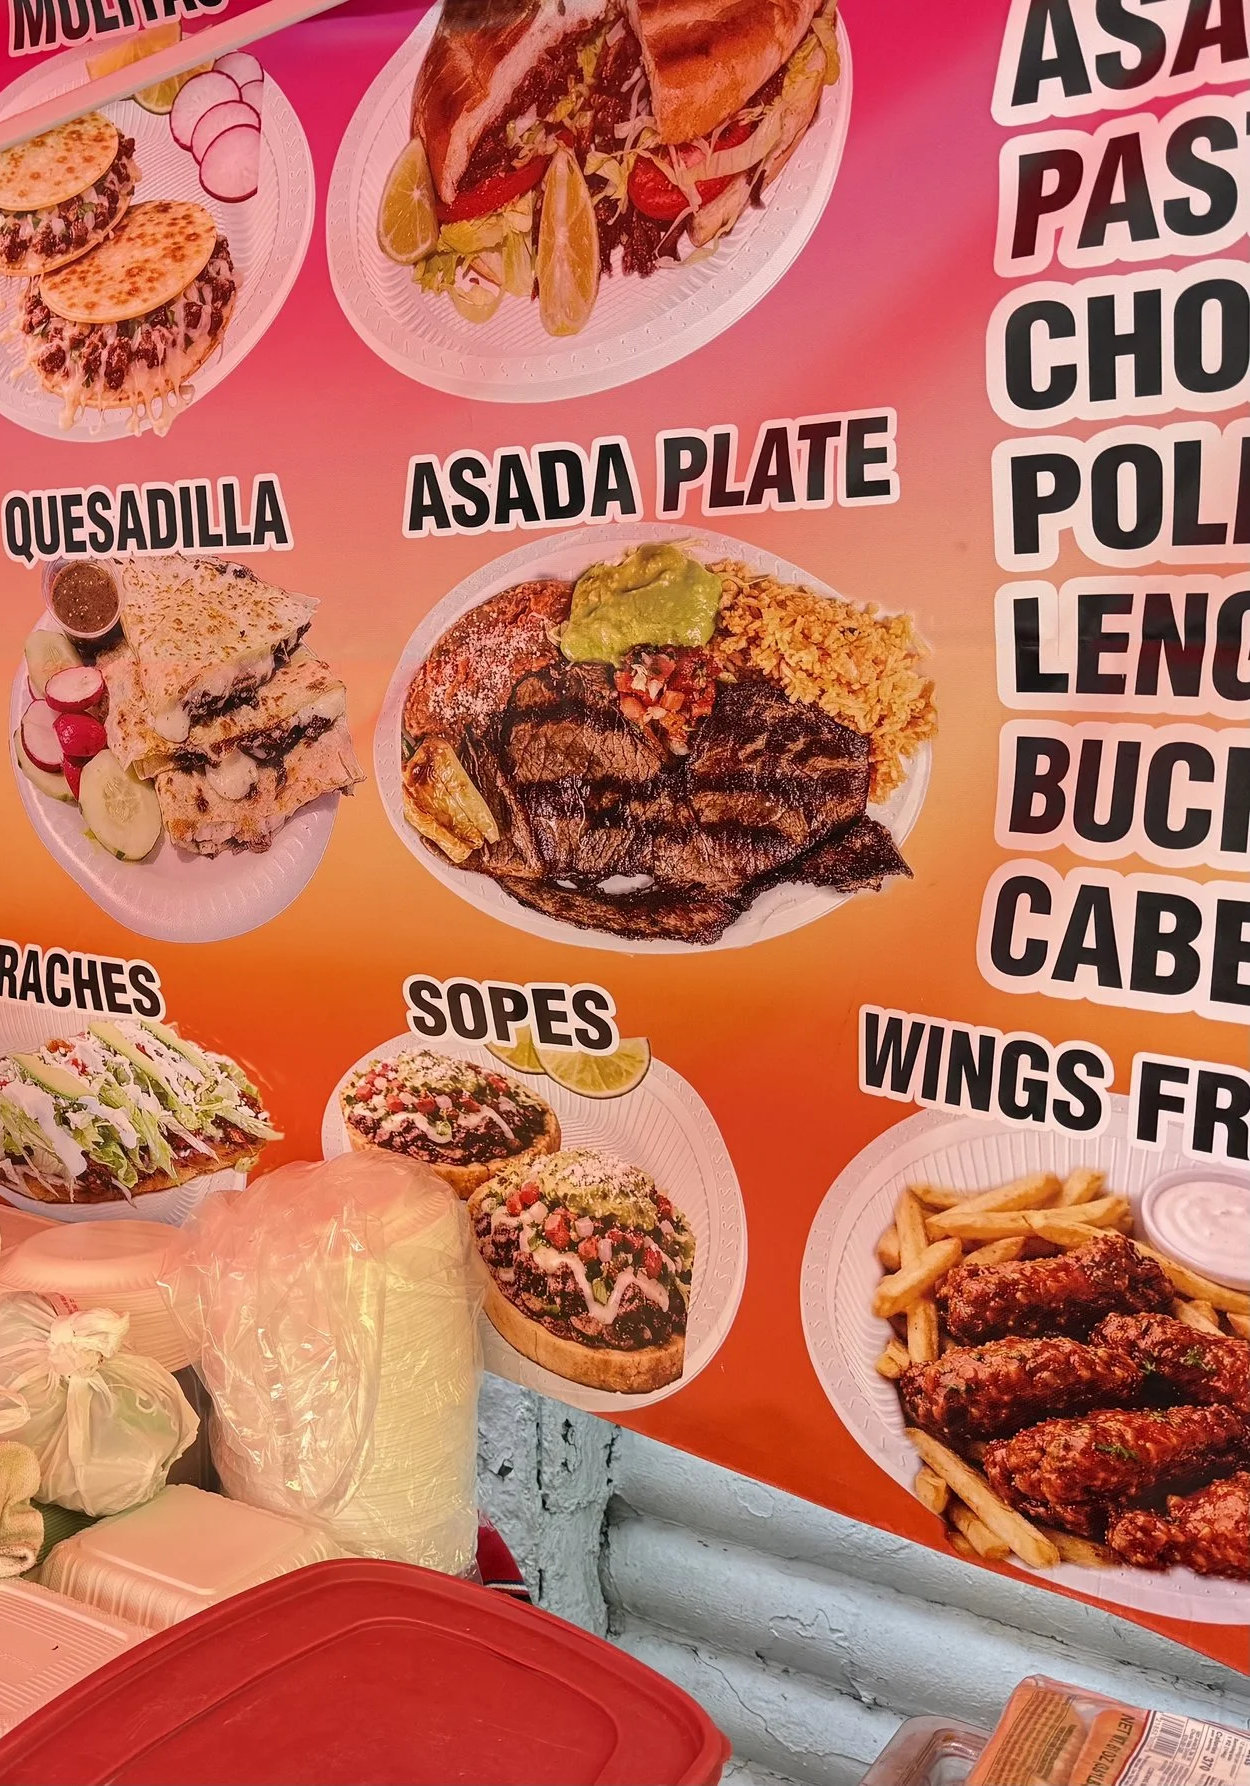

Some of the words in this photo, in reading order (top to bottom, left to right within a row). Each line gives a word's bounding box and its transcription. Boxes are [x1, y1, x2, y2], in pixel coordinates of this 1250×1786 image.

[1011, 111, 1250, 259] PAS
[6, 480, 289, 561] QUESADILLA
[410, 442, 638, 532] ASADA
[661, 417, 892, 512] PLATE
[408, 980, 613, 1051] SOPES
[864, 1012, 1106, 1132] WINGS
[1136, 1061, 1250, 1162] FR
[1199, 1755, 1214, 1772] 370
